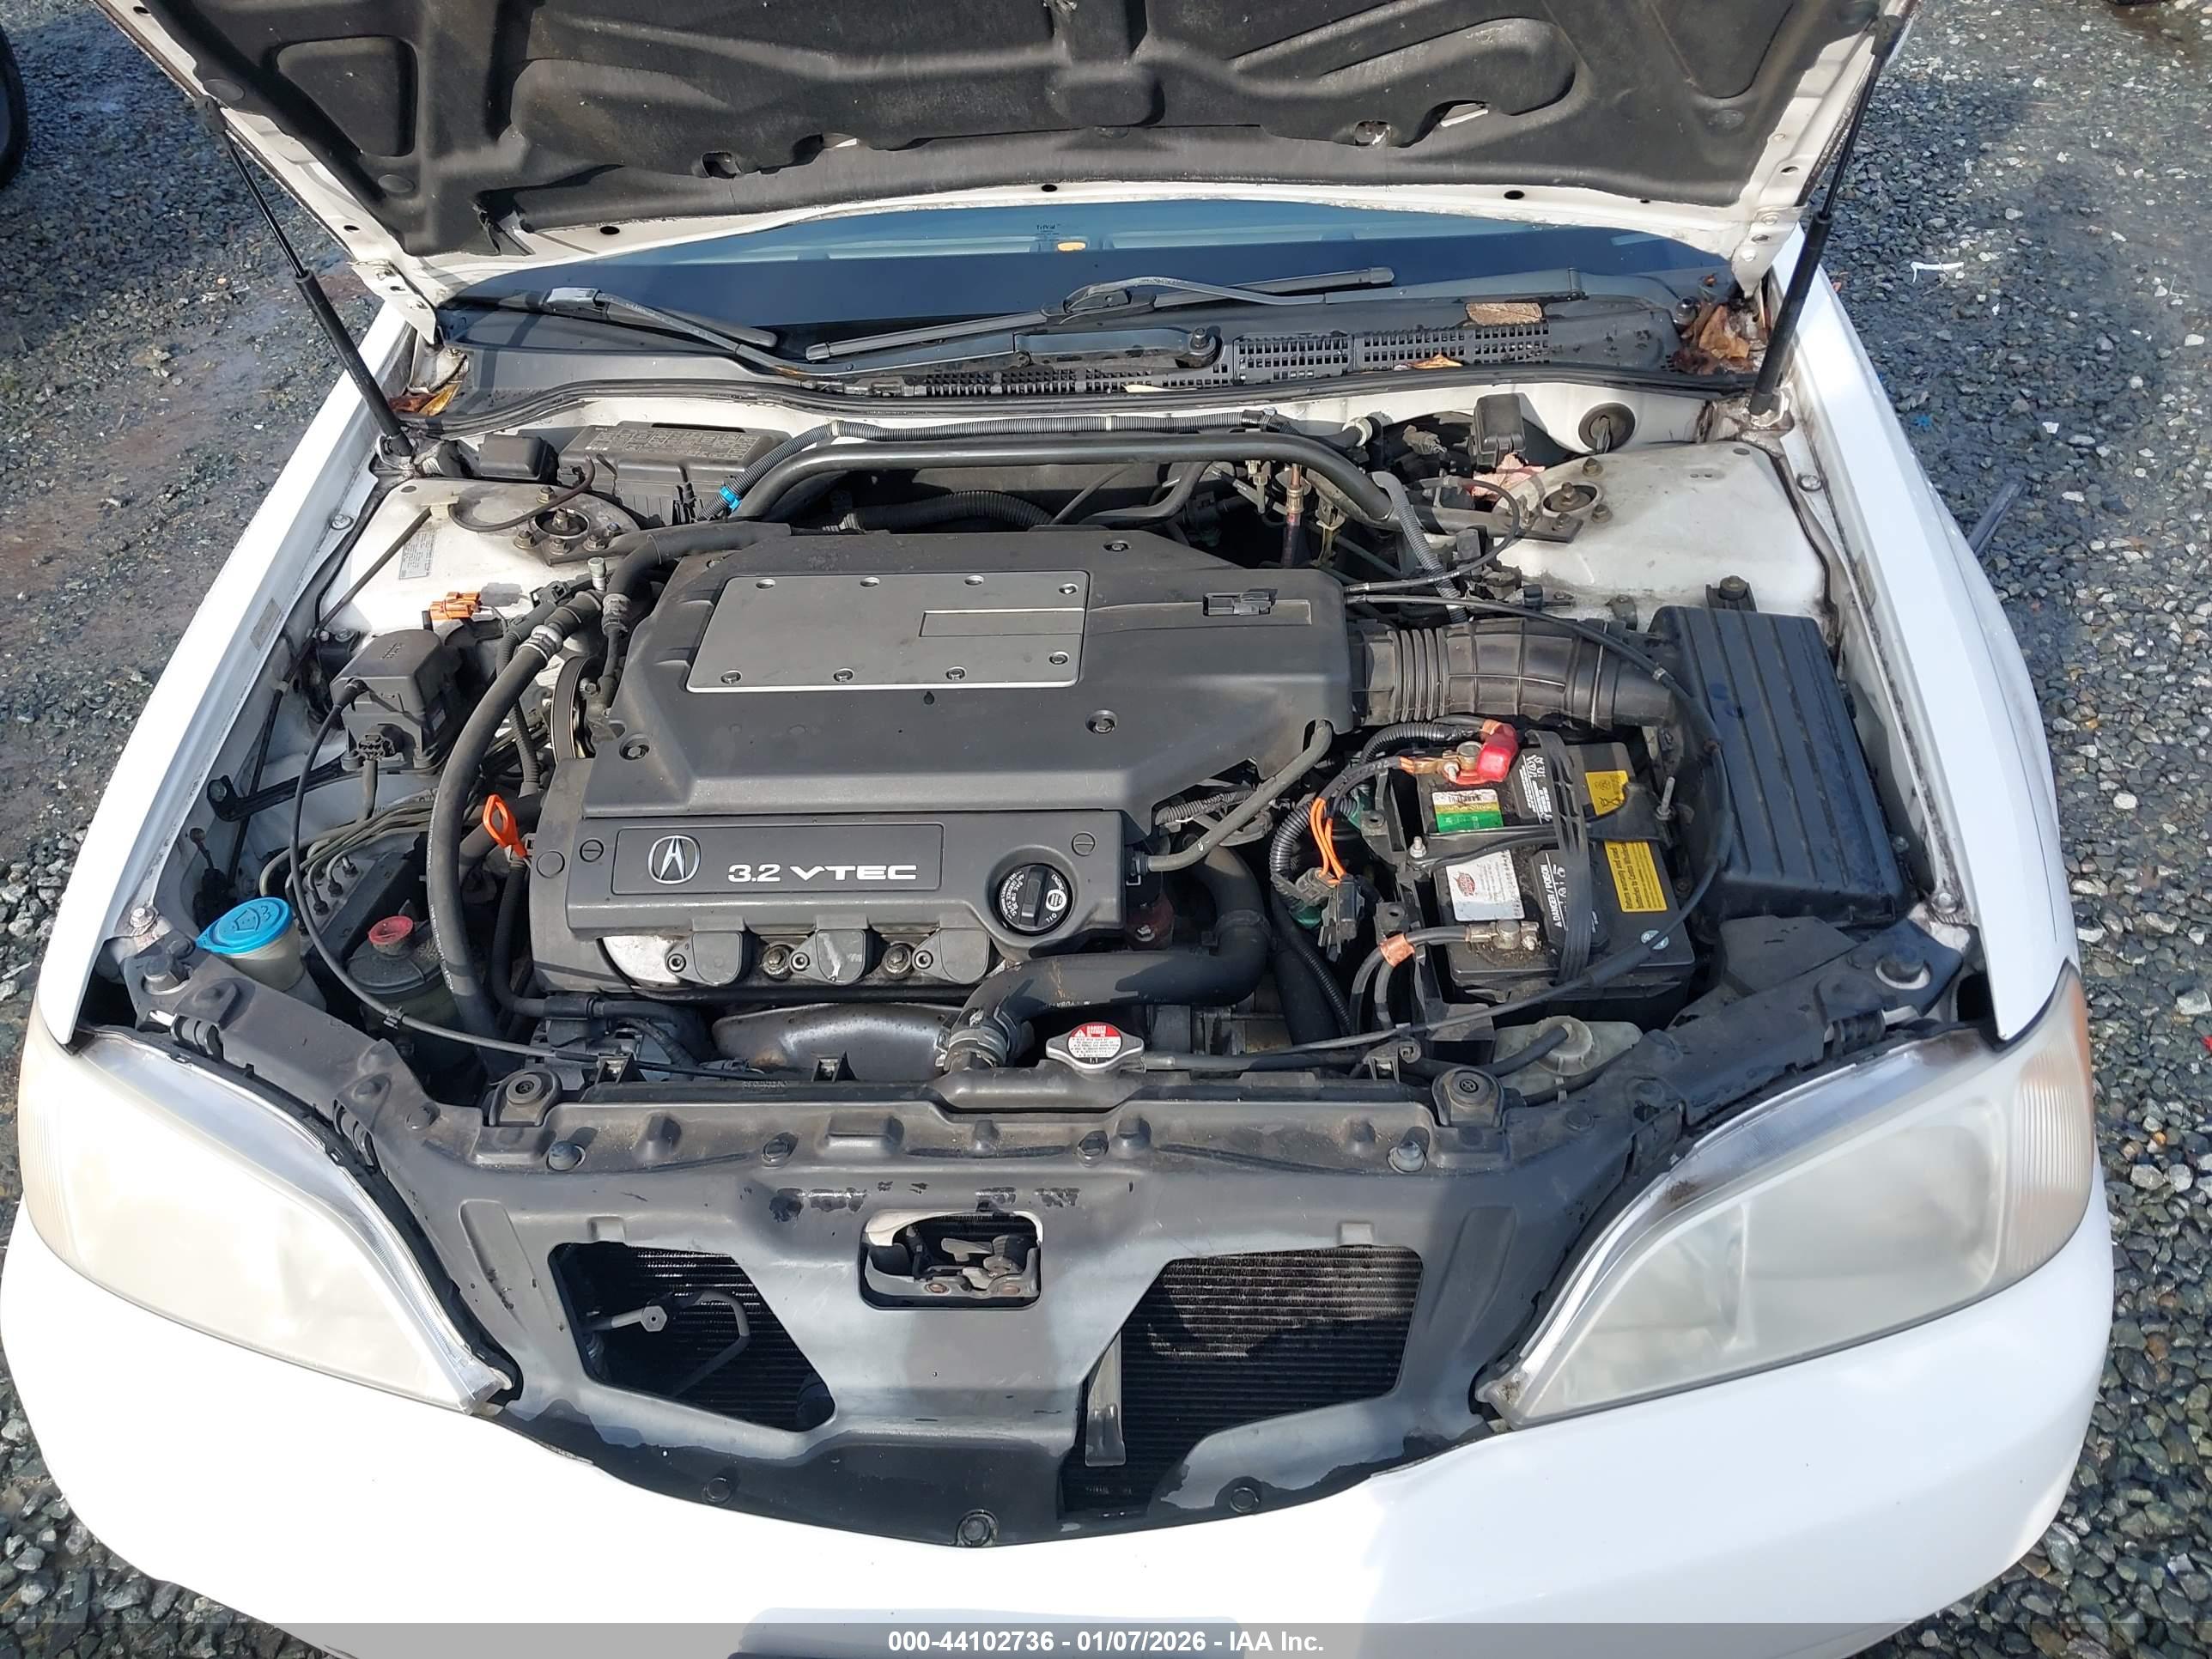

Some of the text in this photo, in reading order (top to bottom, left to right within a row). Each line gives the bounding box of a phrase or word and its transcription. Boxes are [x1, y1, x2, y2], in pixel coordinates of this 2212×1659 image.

[728, 864, 917, 882] 3.2 VTEC
[1540, 865, 1553, 888] POISON
[1547, 894, 1560, 921] DANGER
